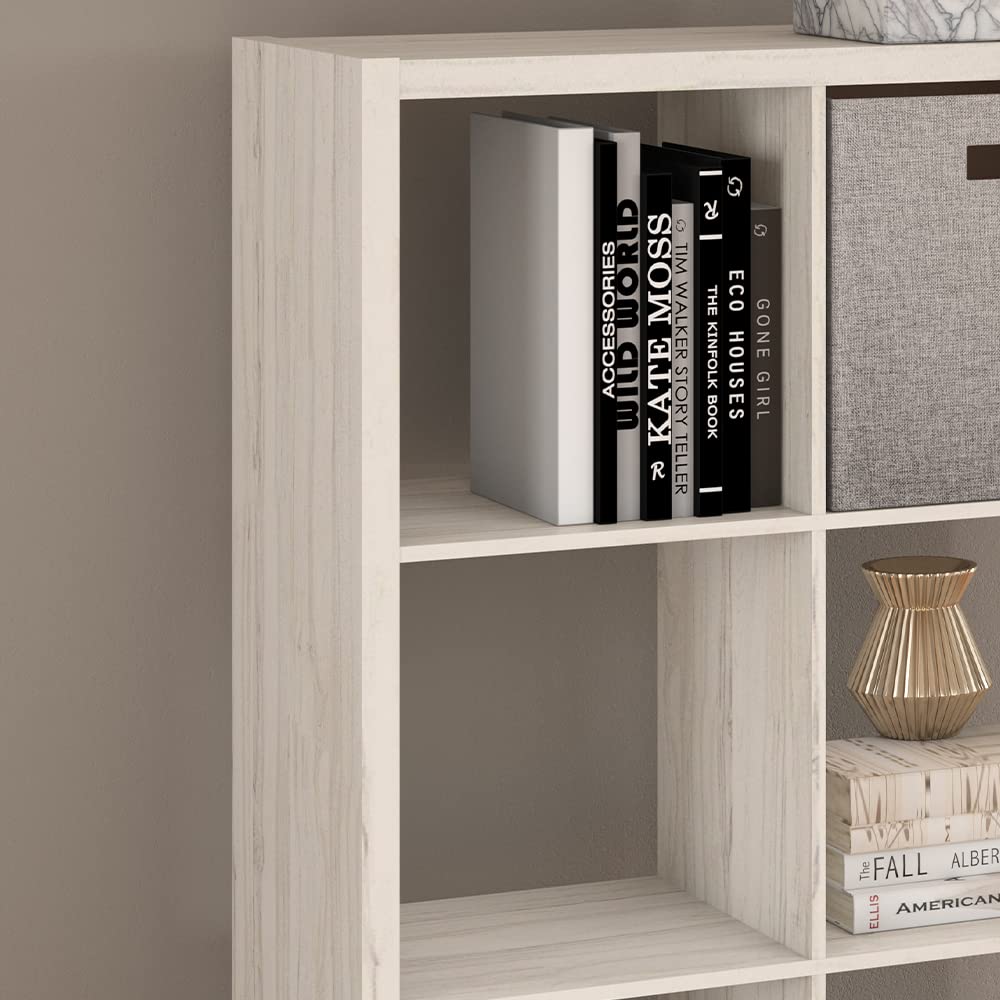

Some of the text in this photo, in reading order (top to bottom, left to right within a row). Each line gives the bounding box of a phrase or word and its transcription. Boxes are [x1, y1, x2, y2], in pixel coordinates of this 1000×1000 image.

[602, 241, 616, 398] ACCESSORIES
[617, 199, 639, 430] WILD WORLD
[648, 213, 671, 446] KATE MOSS
[675, 243, 688, 495] TIM WALKER STORY TELLER
[707, 285, 718, 439] THE KINFOLK BOOK
[729, 270, 744, 419] ECO HOUSES
[757, 299, 770, 420] GONE GIRL
[860, 852, 928, 881] The FALL
[869, 894, 880, 929] ELLIS
[896, 893, 1000, 914] AMERICAN
